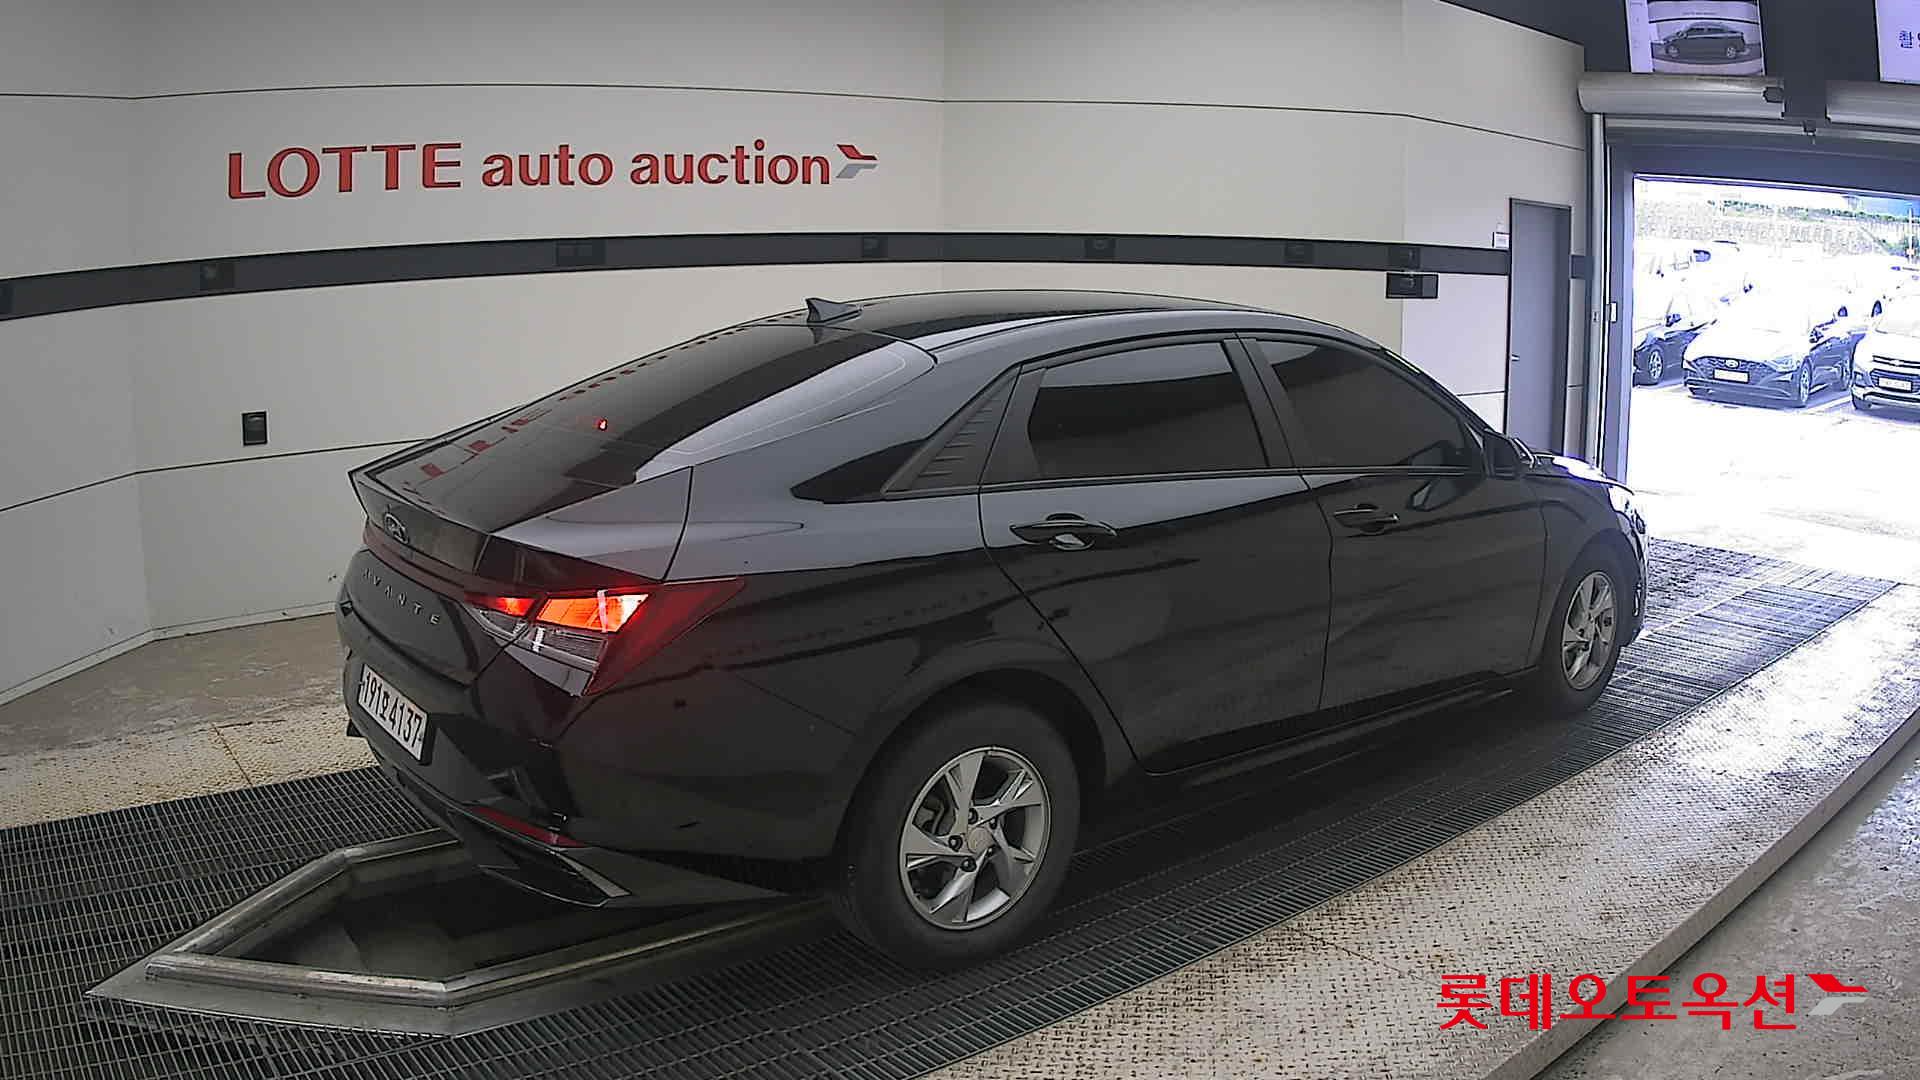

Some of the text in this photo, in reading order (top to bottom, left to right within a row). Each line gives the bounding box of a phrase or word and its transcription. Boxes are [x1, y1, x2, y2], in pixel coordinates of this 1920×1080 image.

[229, 140, 830, 199] LOTTE auto auction
[363, 568, 440, 625] AVANTE
